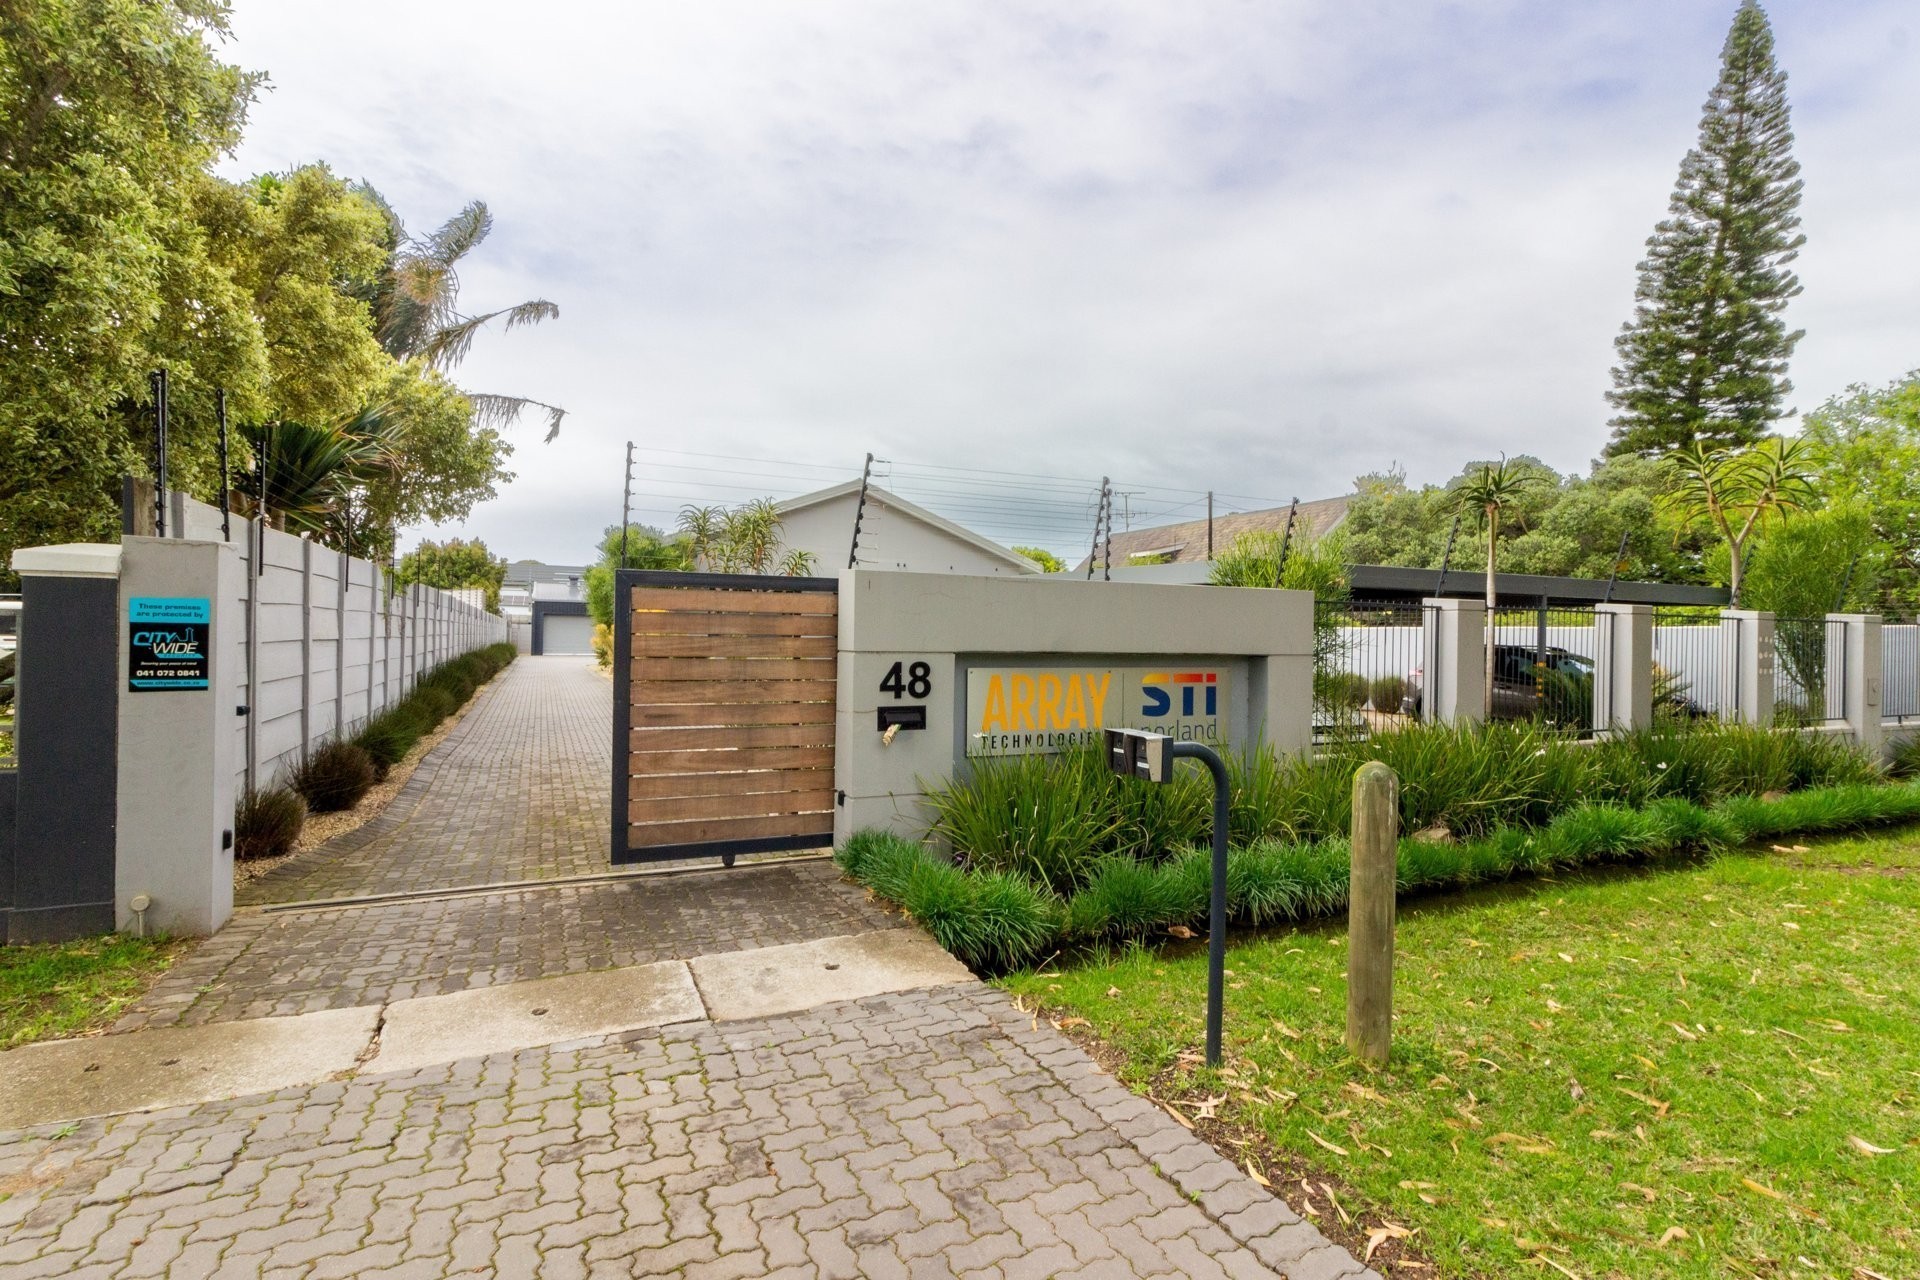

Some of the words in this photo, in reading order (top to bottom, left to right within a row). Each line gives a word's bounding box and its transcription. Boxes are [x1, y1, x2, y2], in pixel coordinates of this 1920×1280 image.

[133, 631, 177, 646] CITY
[153, 642, 199, 654] WIDE
[879, 661, 932, 699] 48
[981, 673, 1112, 731] ARRAY
[981, 732, 1101, 749] TECHNOLOGIE
